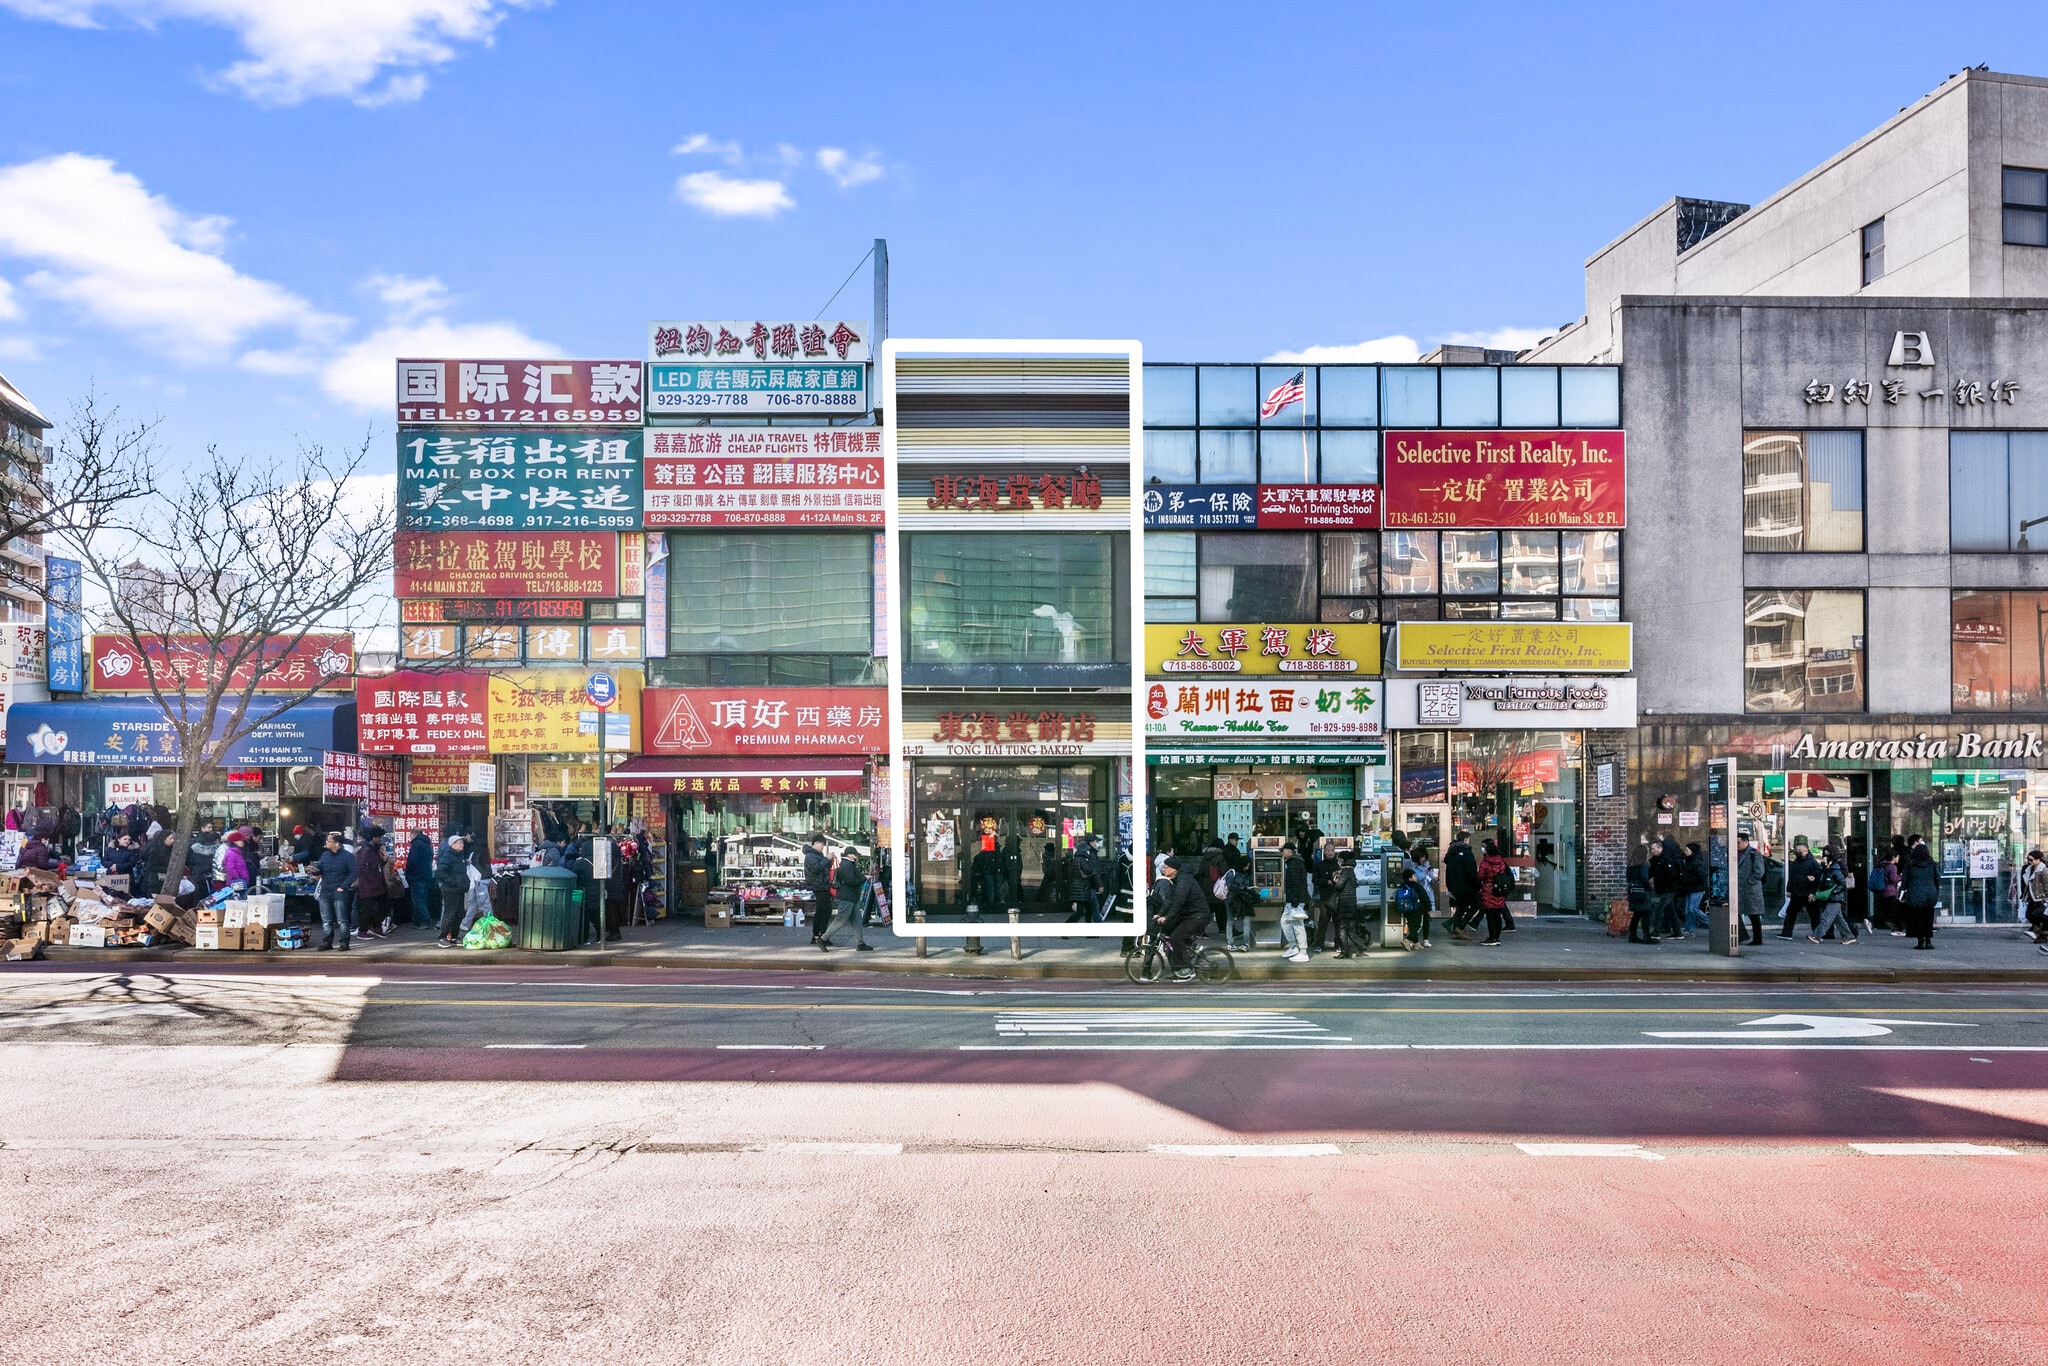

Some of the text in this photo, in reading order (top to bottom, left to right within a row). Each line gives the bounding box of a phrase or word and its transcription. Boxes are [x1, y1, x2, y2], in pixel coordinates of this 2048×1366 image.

[654, 323, 859, 360] 紐約知青聯誼會
[399, 362, 641, 404] 国际汇款
[659, 372, 691, 387] LED
[658, 394, 857, 406] 929-329-7788 706-870-8888
[400, 408, 641, 421] TEL:9172165959
[654, 432, 722, 454] 嘉嘉旅游
[728, 434, 808, 443] JIA JIA TRAVEL
[813, 432, 881, 453] 特價機票
[406, 437, 637, 465] 信箱出租
[728, 445, 808, 454] CHEAP FLIGHTS
[1397, 440, 1613, 467] Selective First Realty, Inc.
[406, 469, 634, 479] MAIL BOX FOR RENT
[654, 463, 881, 485] 簽證 公證 翻譯服務中心
[927, 473, 1103, 511] 東海堂餐廳
[1262, 488, 1376, 503] 大軍汽車駕駛學校
[1419, 478, 1592, 503] 一定好 置業公司
[651, 494, 670, 507] 打字
[717, 494, 735, 507] 名片
[781, 494, 801, 507] 照相
[844, 494, 882, 507] 信箱出租
[1168, 491, 1253, 513] 第一保險
[1289, 504, 1372, 516] No.1 Driving School
[650, 514, 712, 523] 929-329-7788
[725, 514, 786, 523] 706-870-8888
[800, 514, 831, 523] 41-12A
[833, 514, 854, 523] Main
[856, 514, 869, 523] St.
[1158, 515, 1239, 524] INSURANCE 718 353 7578
[1390, 512, 1456, 525] 718-461-2510
[1527, 512, 1556, 525] 41-10
[1559, 512, 1581, 525] Main
[1583, 512, 1596, 525] St.
[1598, 512, 1605, 525] 2
[408, 539, 602, 571] 法拉盛駕駛學校
[410, 581, 485, 593] 41-14 MAIN ST. 2FL
[1178, 626, 1340, 657] 大軍駕校
[1452, 628, 1578, 644] 一定好 置業公司
[1426, 644, 1603, 658] Selective First Realty, Inc.
[1169, 661, 1351, 670] 718-886-8002 718-886-1881
[374, 690, 469, 708] 國際匯款
[1469, 686, 1607, 699] Xi'an Famous Foods
[1174, 685, 1376, 716] 蘭州拉面 奶茶
[1496, 702, 1607, 710] WESTERN CHINESE CUISINE
[360, 712, 418, 725] 信箱出租
[710, 698, 883, 729] 頂好 西藥房
[112, 723, 170, 732] STARSIDE
[932, 711, 1096, 745] 東海堂餅店
[1323, 723, 1378, 732] 929-599-8988
[427, 730, 461, 739] FEDEX
[464, 730, 485, 739] DHL
[735, 735, 865, 745] PREMIUM PHARMACY
[902, 746, 924, 755] 41-12
[947, 745, 1084, 755] TONG HAI TUNG BAKERY
[1791, 731, 2043, 759] Amerasia Bank
[1208, 756, 1229, 764] Ramen
[1234, 756, 1254, 764] Bubble
[1255, 756, 1266, 764] Tea
[1319, 756, 1339, 764] Ramen
[1345, 756, 1365, 764] Bubble
[1365, 756, 1377, 764] Tea
[112, 783, 147, 793] DE LI
[760, 778, 827, 791] 零食小铺
